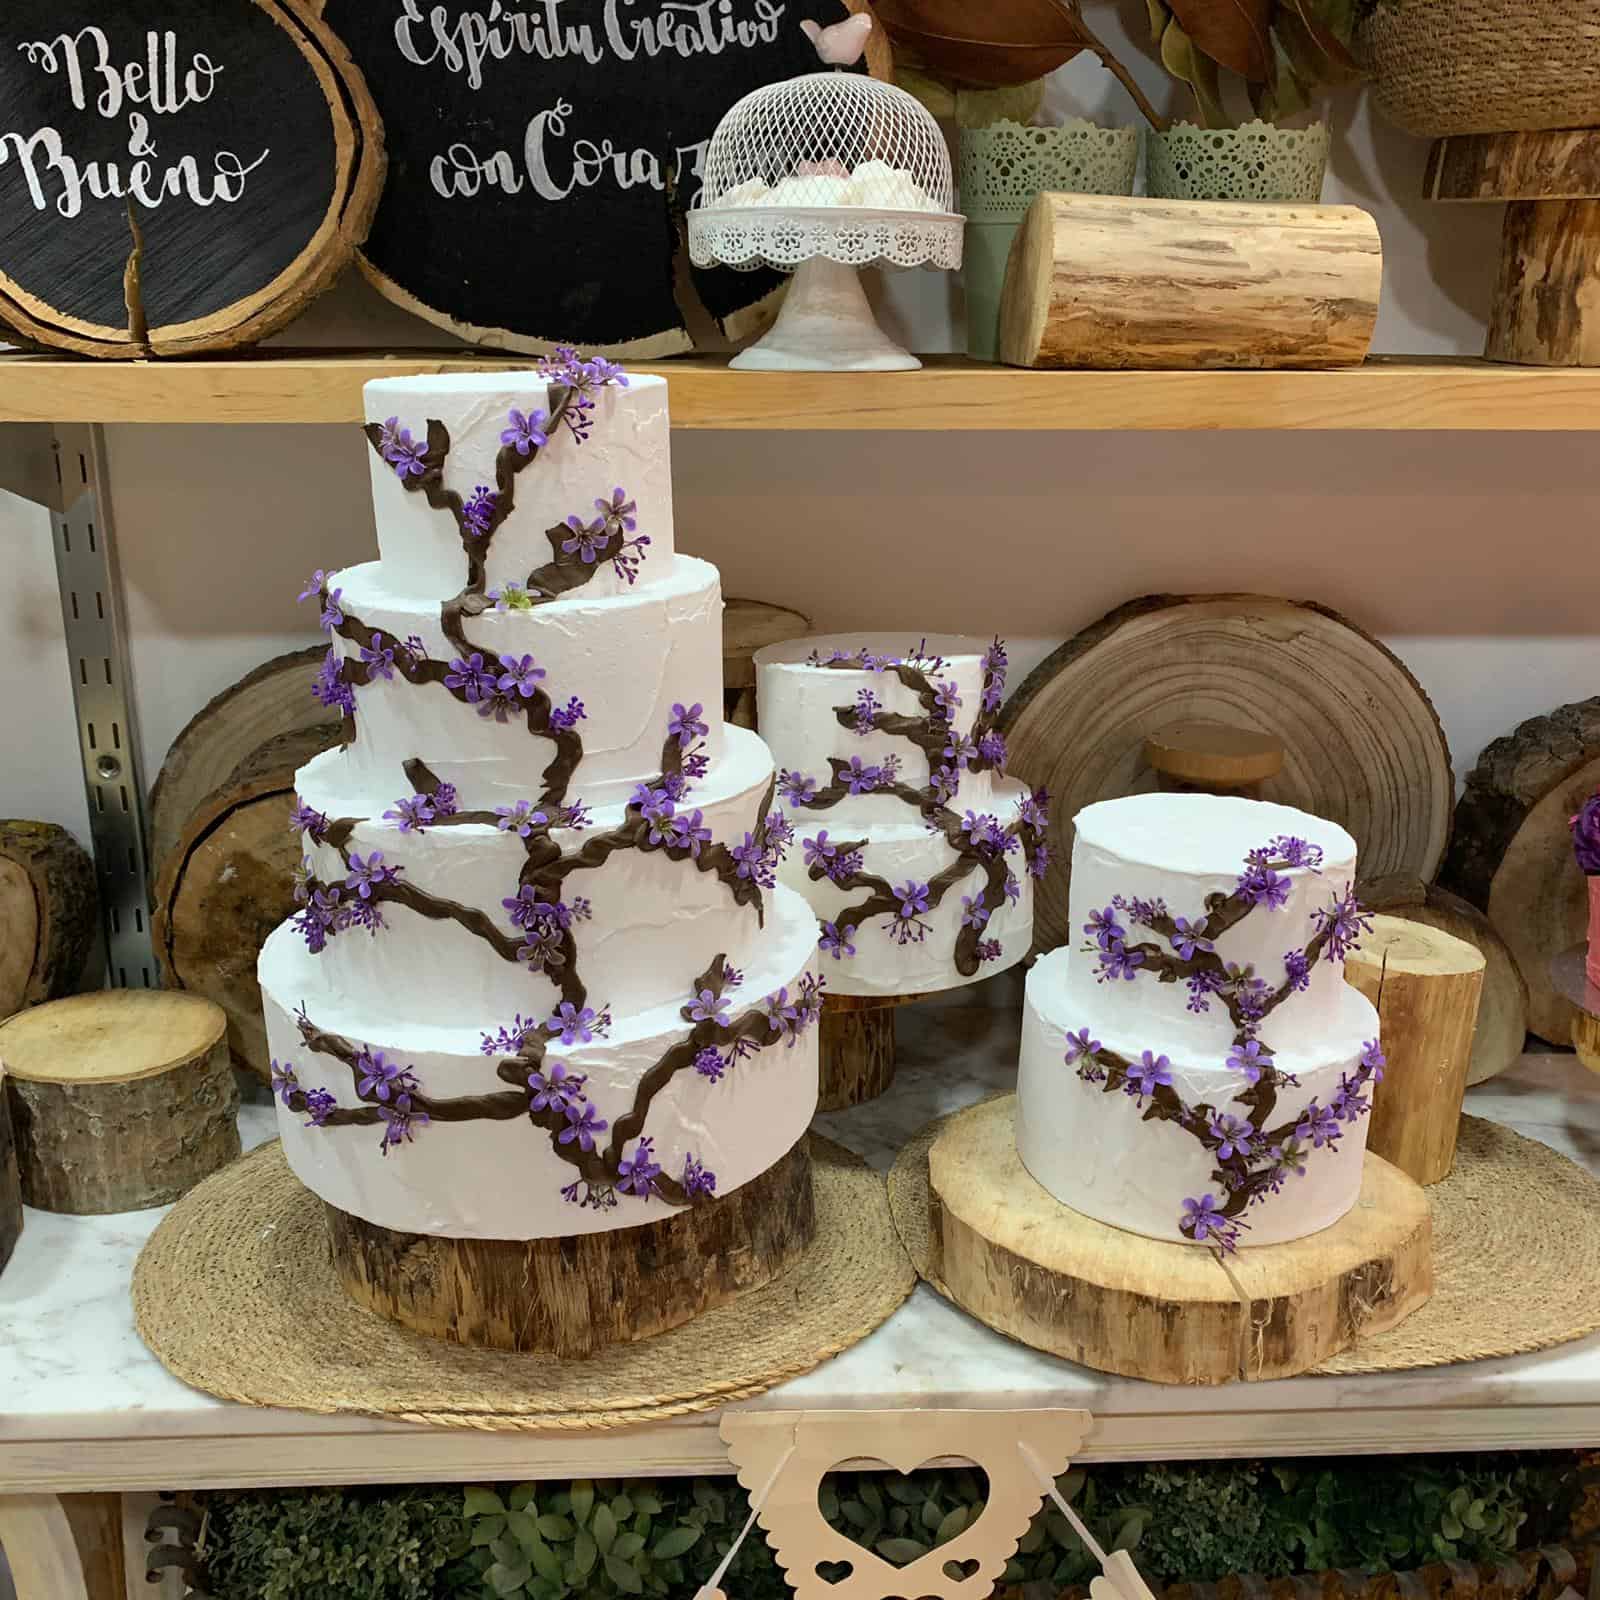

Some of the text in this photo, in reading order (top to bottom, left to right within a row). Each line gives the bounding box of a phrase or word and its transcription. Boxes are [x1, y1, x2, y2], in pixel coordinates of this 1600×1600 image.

[603, 0, 785, 61] Creativo
[17, 26, 224, 118] Bello
[128, 112, 158, 158] &
[0, 127, 270, 218] Bueno
[430, 143, 523, 198] con
